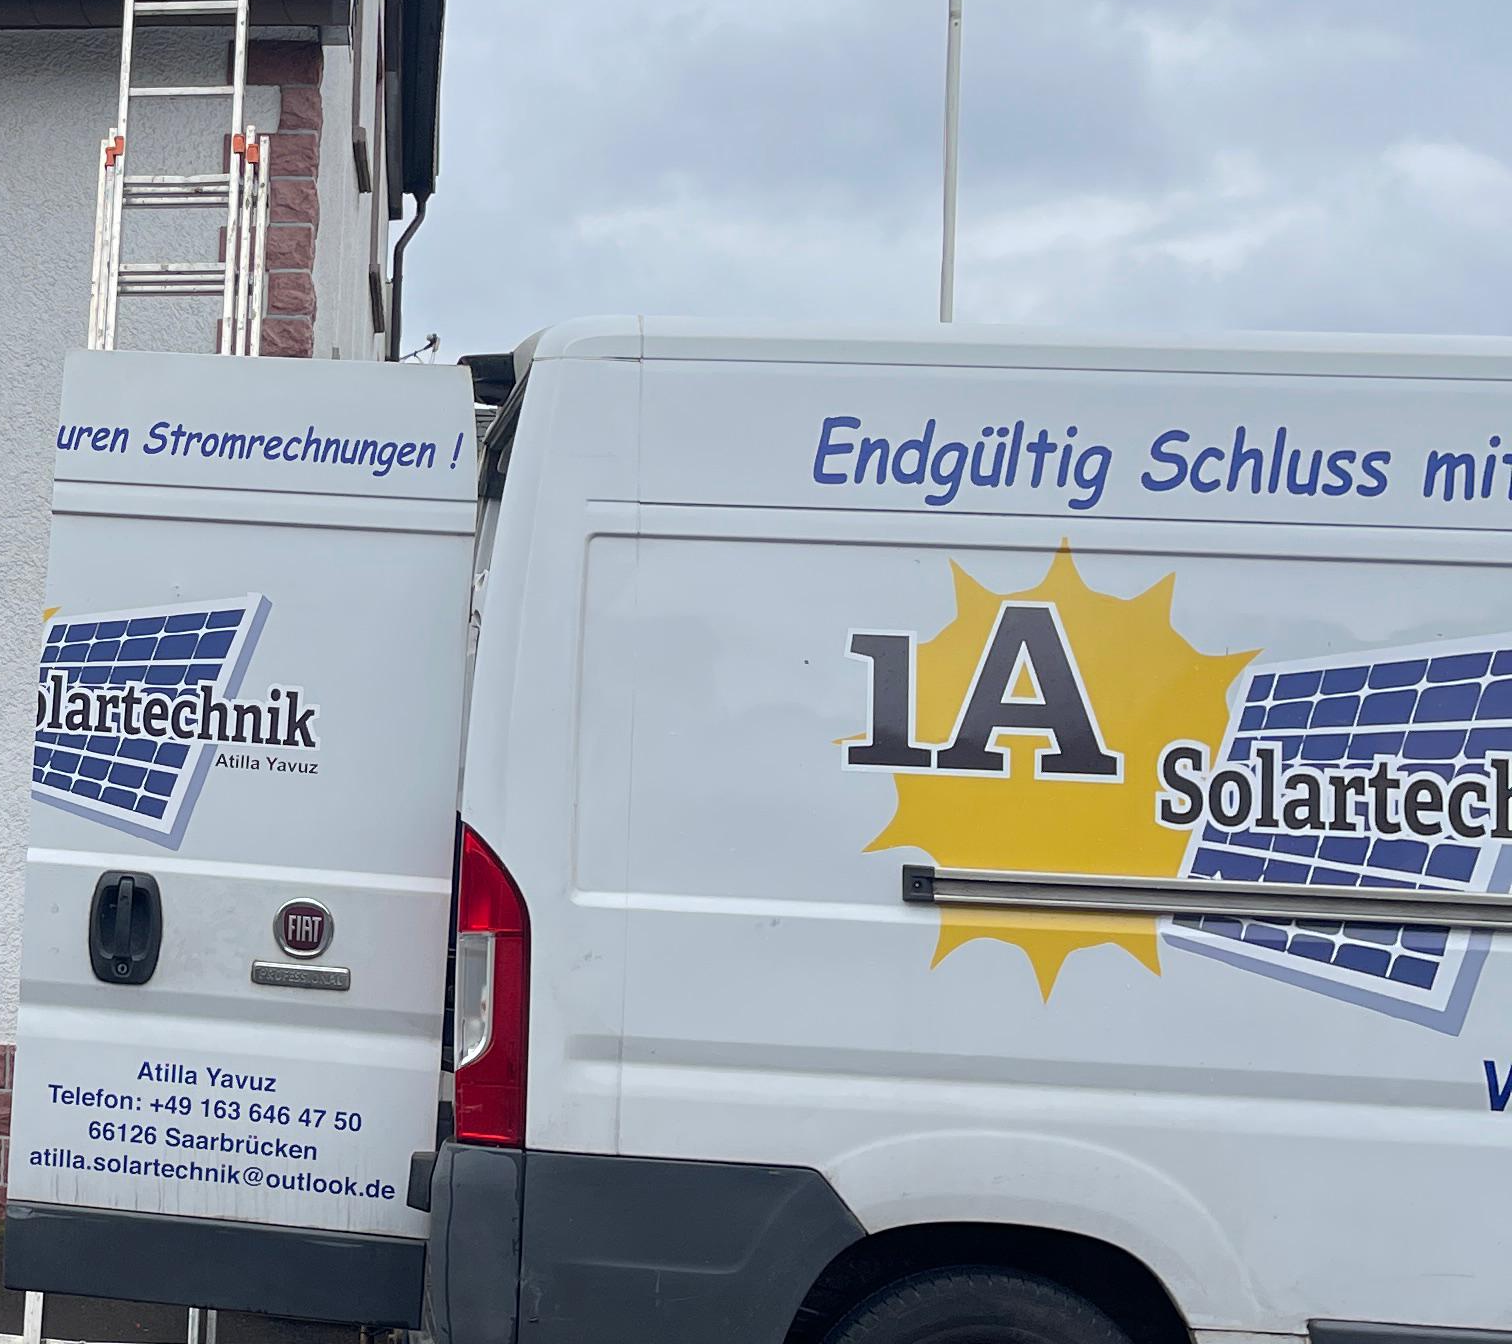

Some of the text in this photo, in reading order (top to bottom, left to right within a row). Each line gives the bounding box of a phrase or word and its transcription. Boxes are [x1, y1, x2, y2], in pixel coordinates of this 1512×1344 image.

[56, 421, 464, 477] uren Stromrechnungen !
[813, 416, 1113, 509] Endgültig
[1140, 425, 1392, 498] Schluss
[847, 605, 1118, 776] 1A
[215, 752, 319, 775] Atilla Yavuz
[288, 914, 323, 943] FIAT
[137, 1061, 277, 1093] Atilla Yavuz
[48, 1084, 362, 1132] Telefon: +49 163 646 47 50
[88, 1120, 318, 1161] 66126 Saarbrücken
[28, 1148, 396, 1201] atilla.solartechnik@outlook.de
